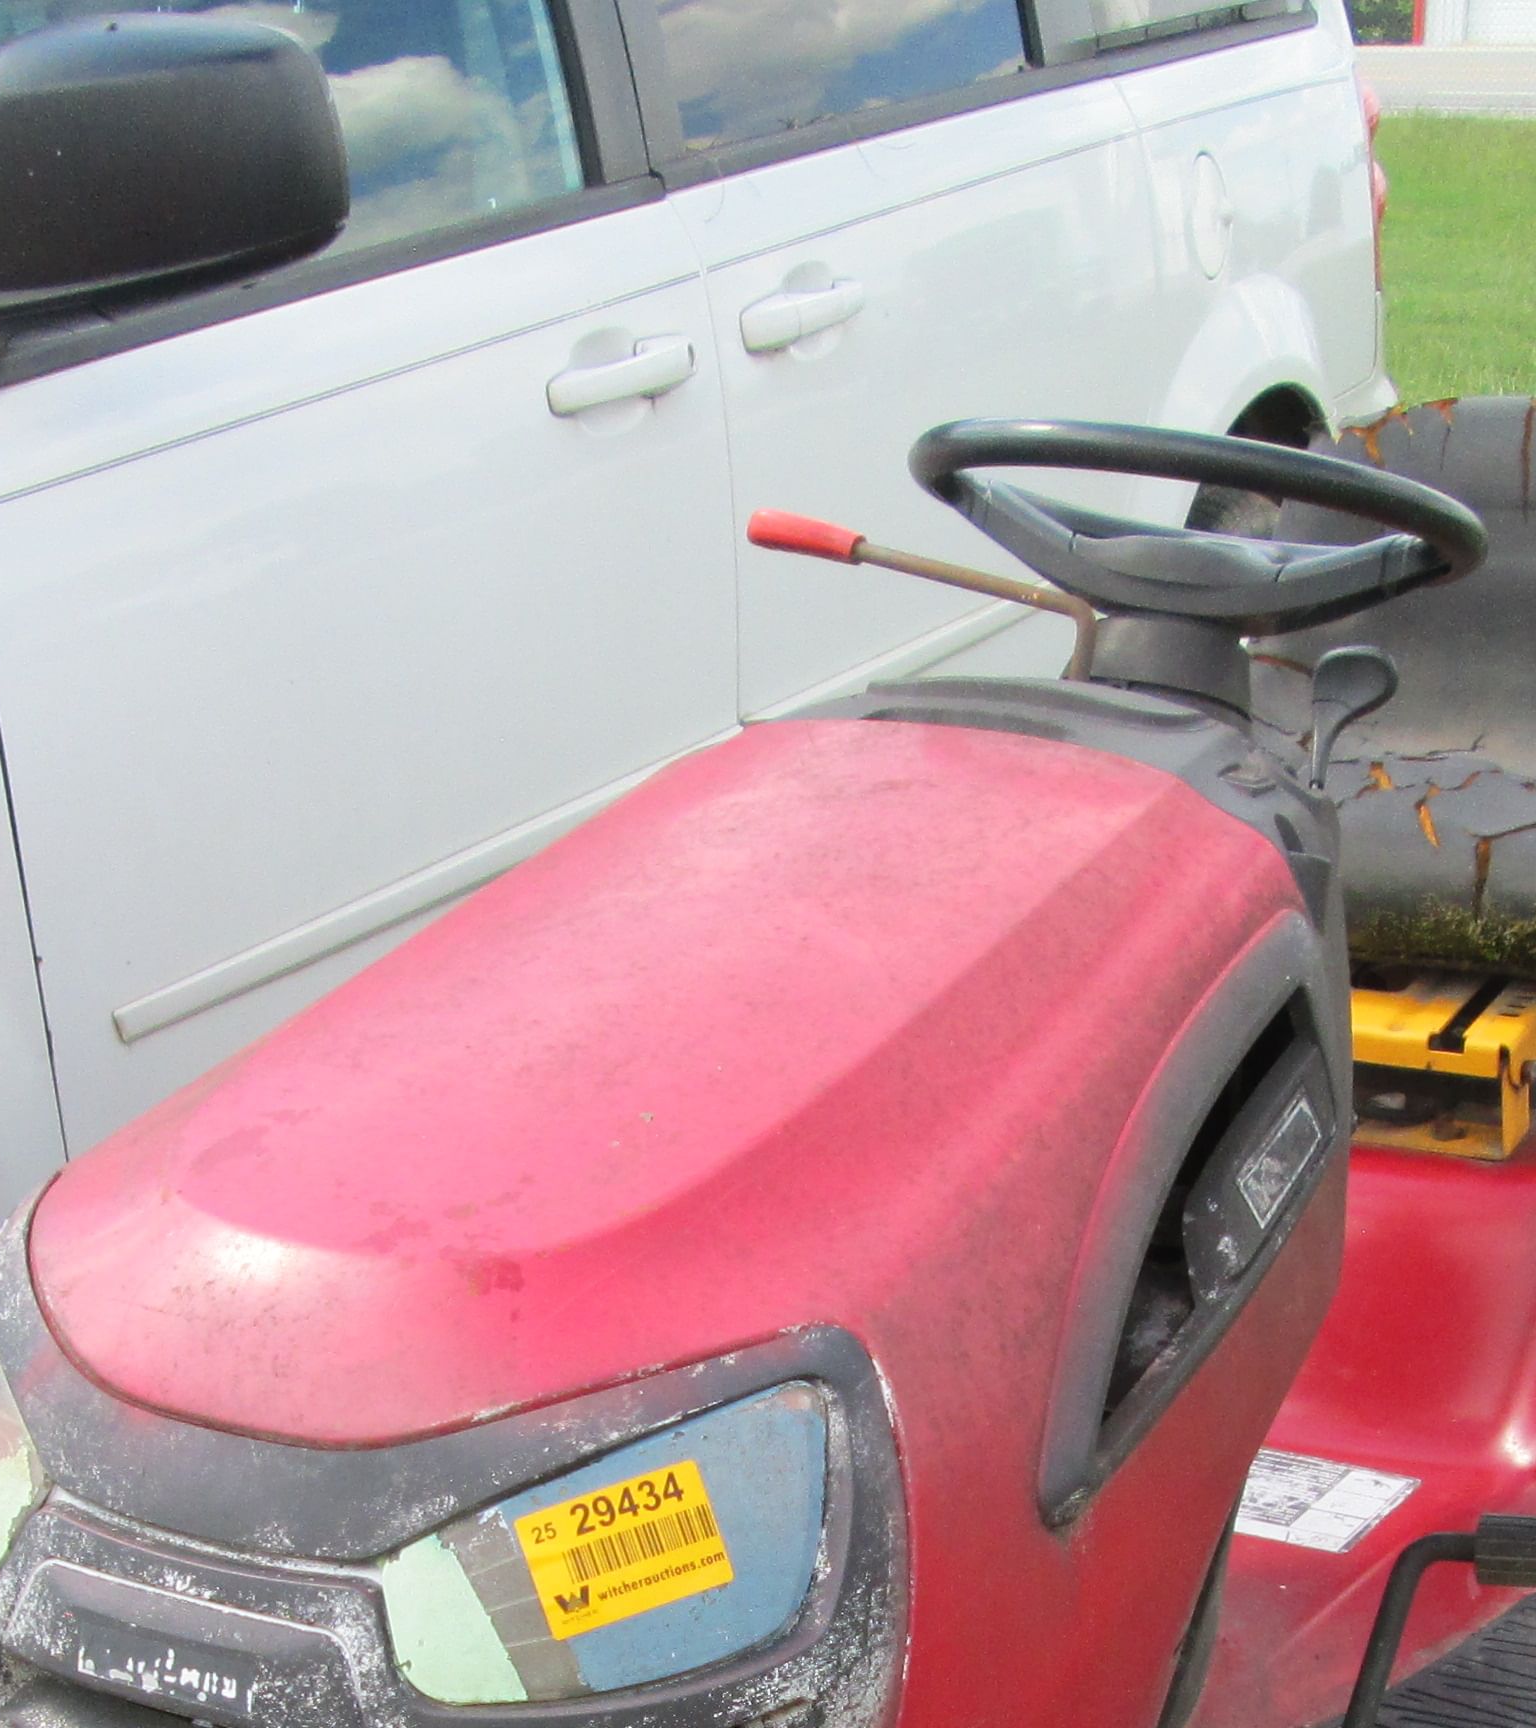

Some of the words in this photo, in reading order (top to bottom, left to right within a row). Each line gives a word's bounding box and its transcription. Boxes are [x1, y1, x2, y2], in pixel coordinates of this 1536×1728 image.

[531, 1522, 557, 1545] 25
[569, 1471, 684, 1536] 29434
[597, 1551, 726, 1601] witcherauctions.com
